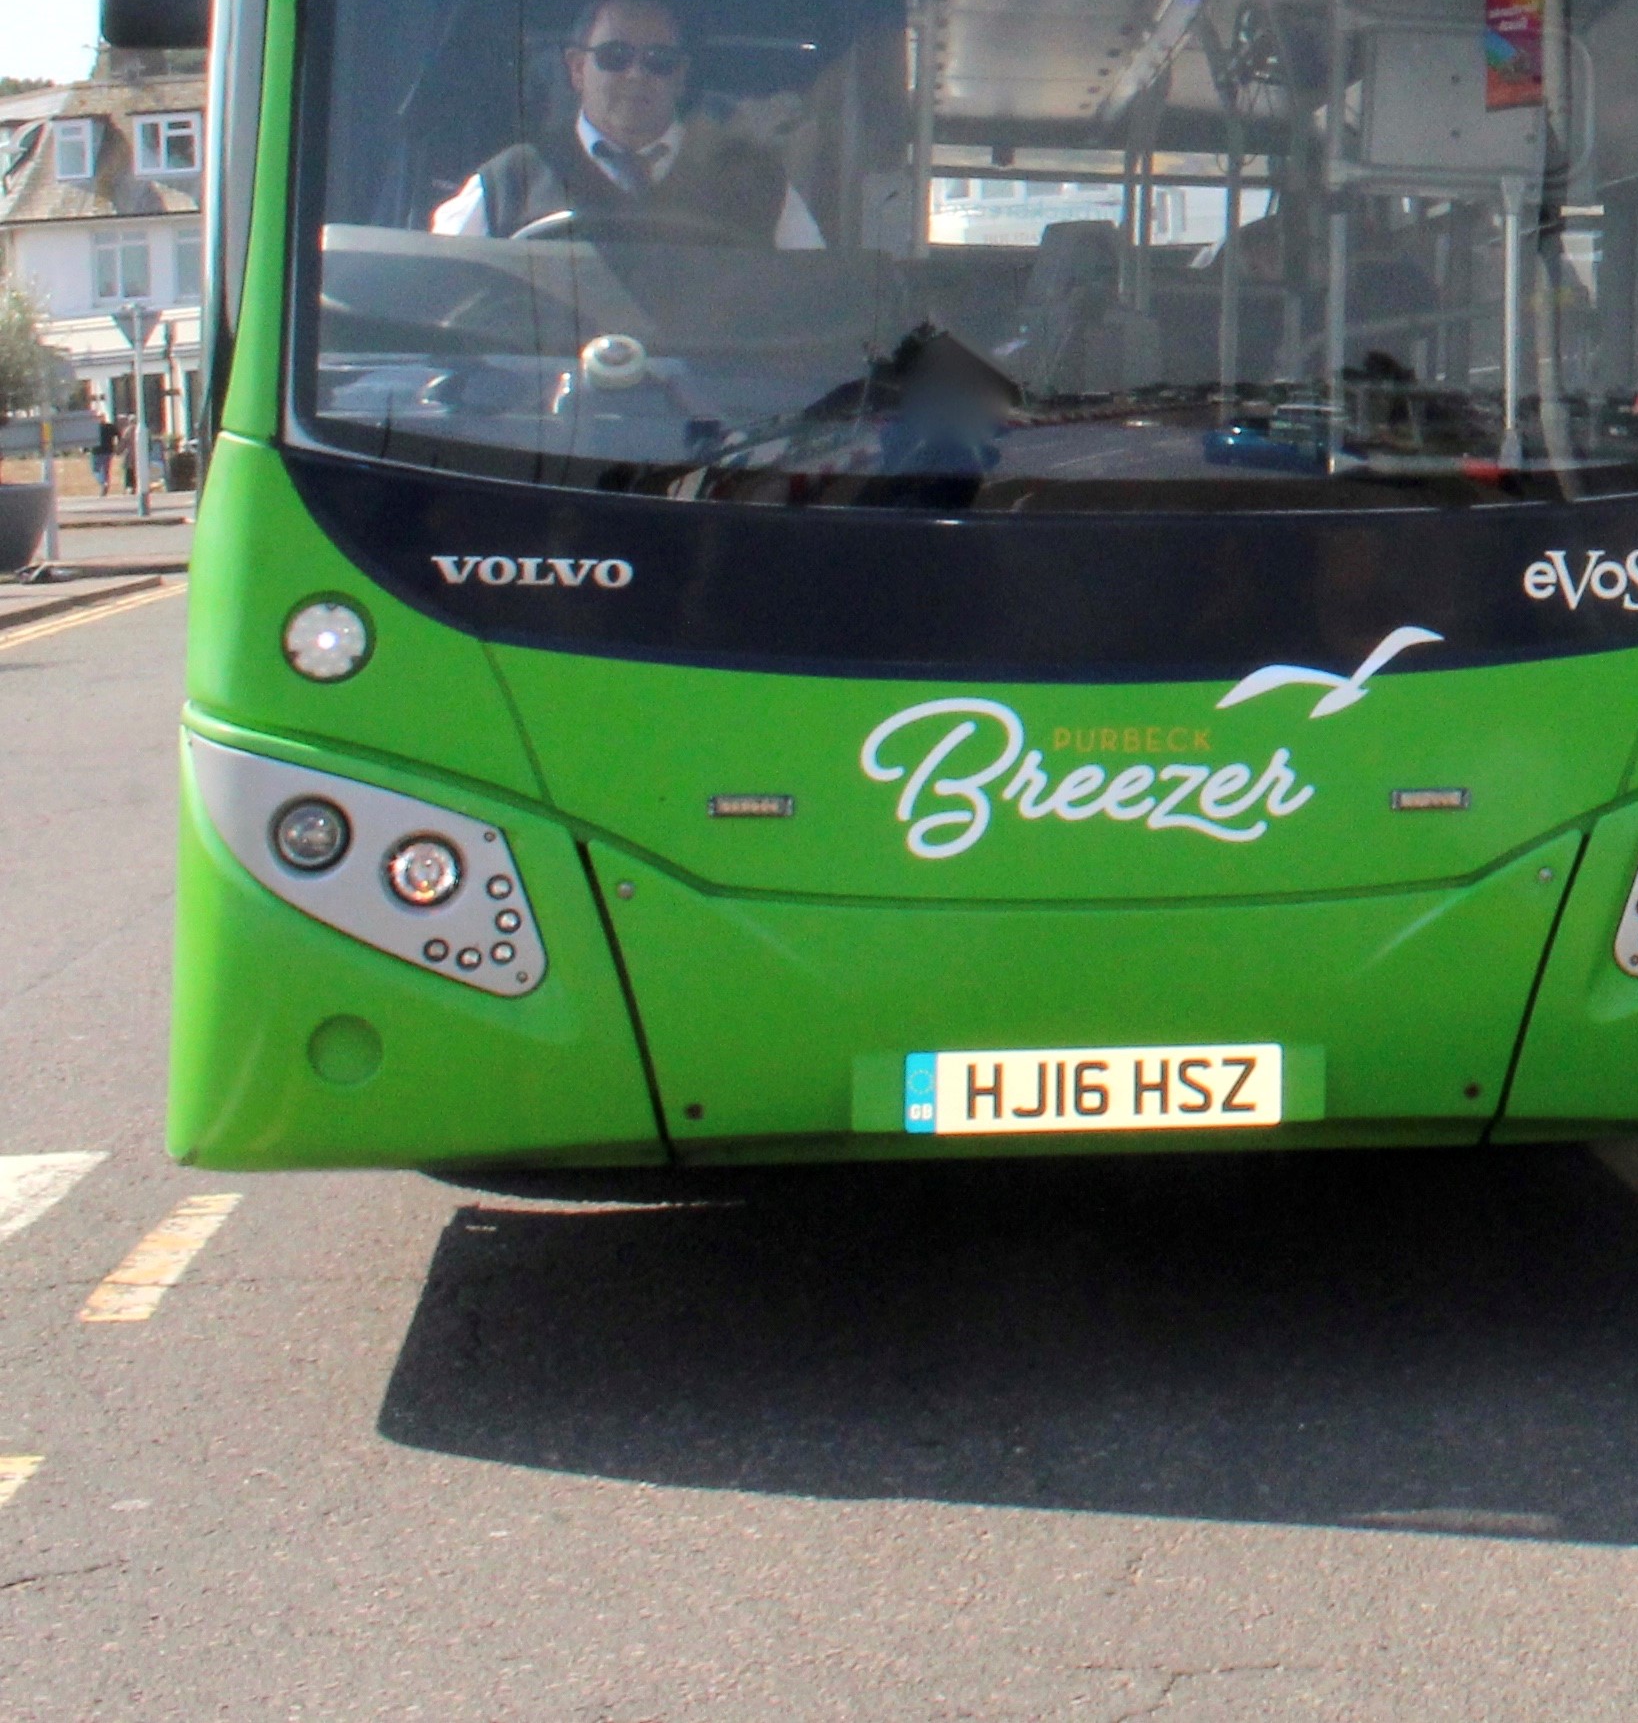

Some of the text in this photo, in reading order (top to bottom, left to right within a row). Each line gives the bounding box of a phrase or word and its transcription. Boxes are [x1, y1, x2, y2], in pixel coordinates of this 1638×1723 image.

[431, 555, 633, 588] VOLVO
[1053, 726, 1211, 754] PURBECK
[860, 697, 1315, 859] Breezer
[966, 1056, 1258, 1120] HJ16 HSZ
[910, 1103, 933, 1120] GB
